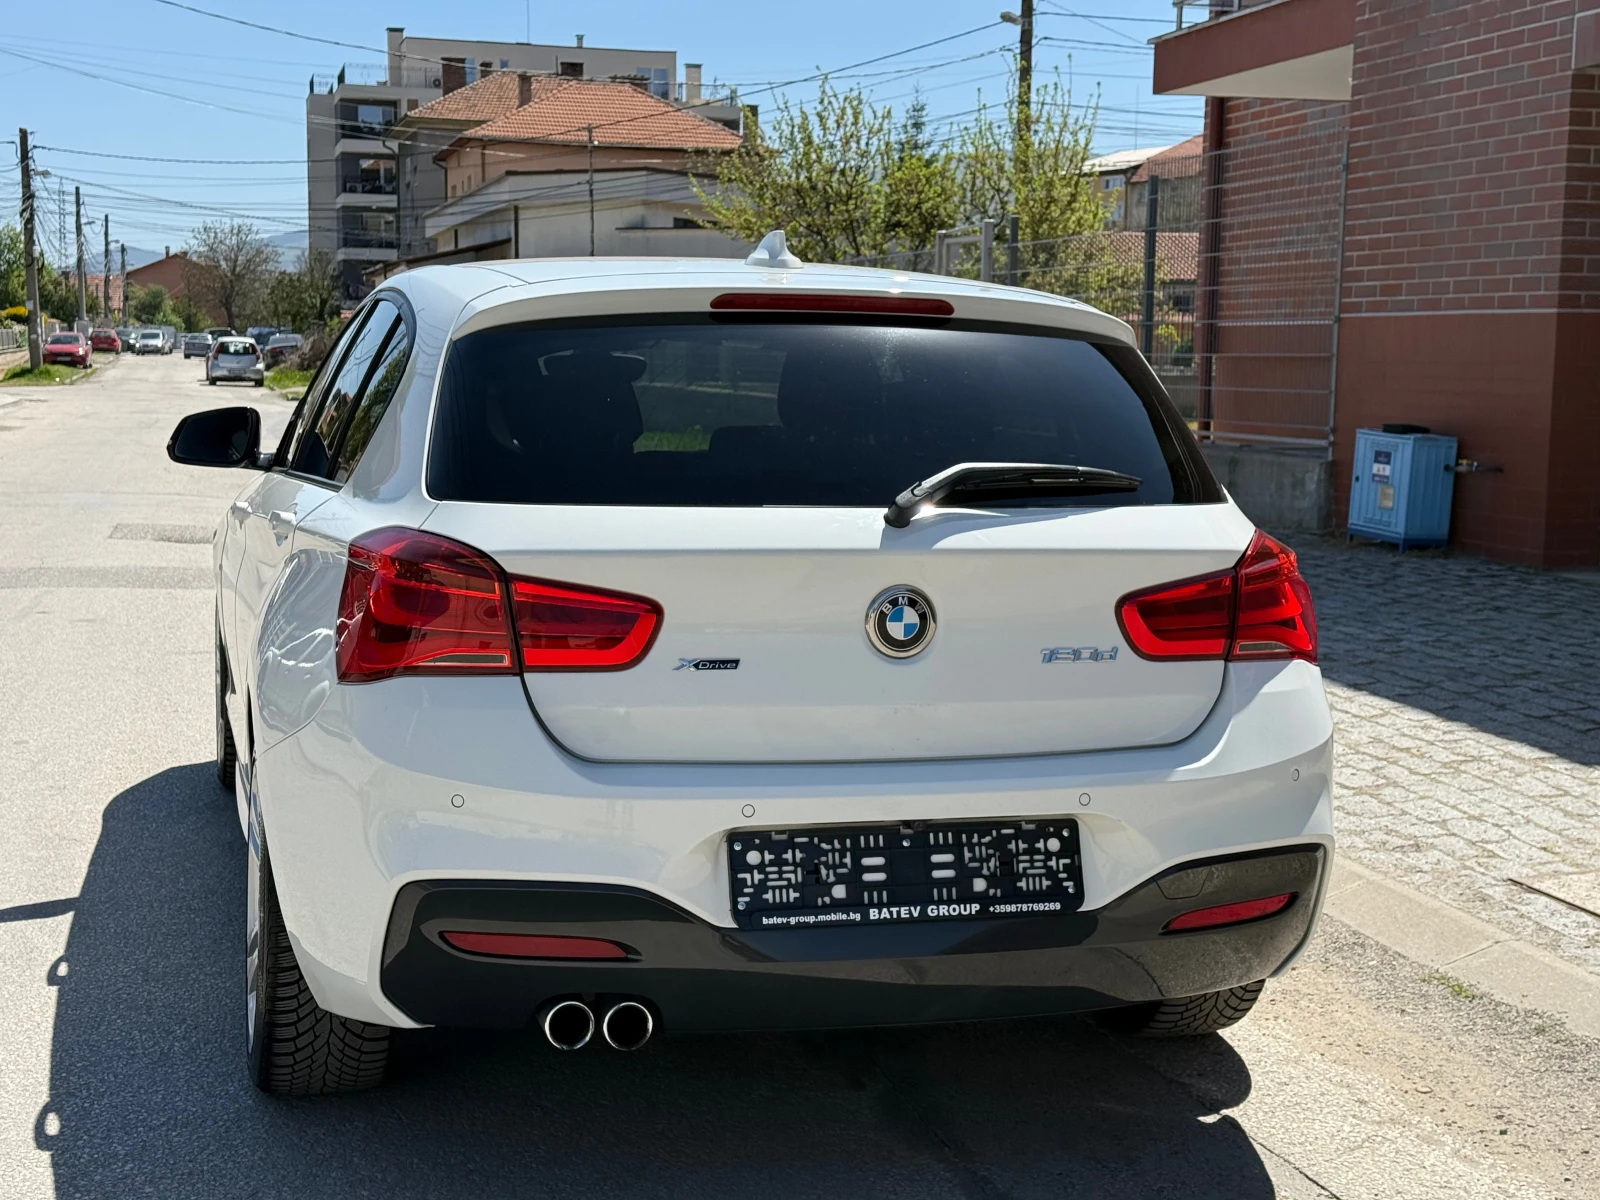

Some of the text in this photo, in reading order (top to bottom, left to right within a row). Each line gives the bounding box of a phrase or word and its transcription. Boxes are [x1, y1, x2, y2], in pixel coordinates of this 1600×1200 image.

[882, 596, 925, 615] BMW
[762, 902, 1062, 925] batev-group.mobile.bg BATEV GROUP +359878769269
